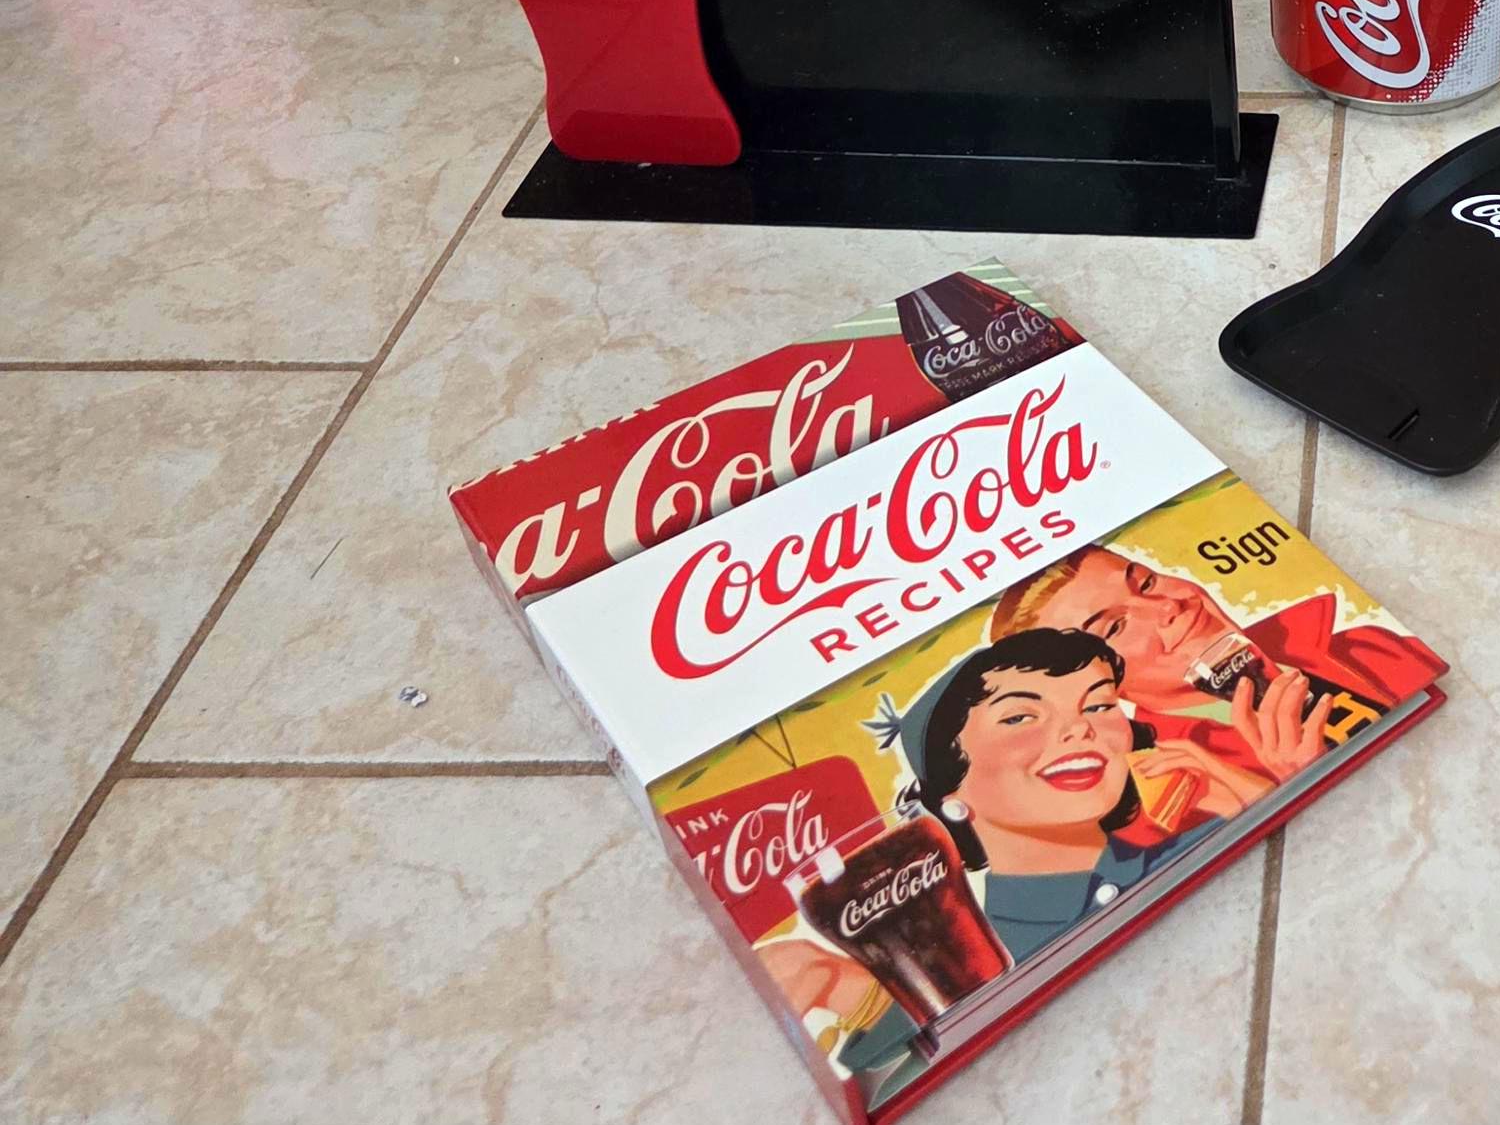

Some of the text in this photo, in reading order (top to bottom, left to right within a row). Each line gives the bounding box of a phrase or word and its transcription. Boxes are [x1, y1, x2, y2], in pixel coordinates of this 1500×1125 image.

[924, 305, 1052, 378] Coca-Cola
[650, 373, 1099, 680] Coca-Cola
[1197, 521, 1291, 575] Sign
[810, 510, 1077, 664] RECIPES
[1210, 646, 1256, 690] Coca-Cola
[840, 849, 948, 937] Coca-Cola
